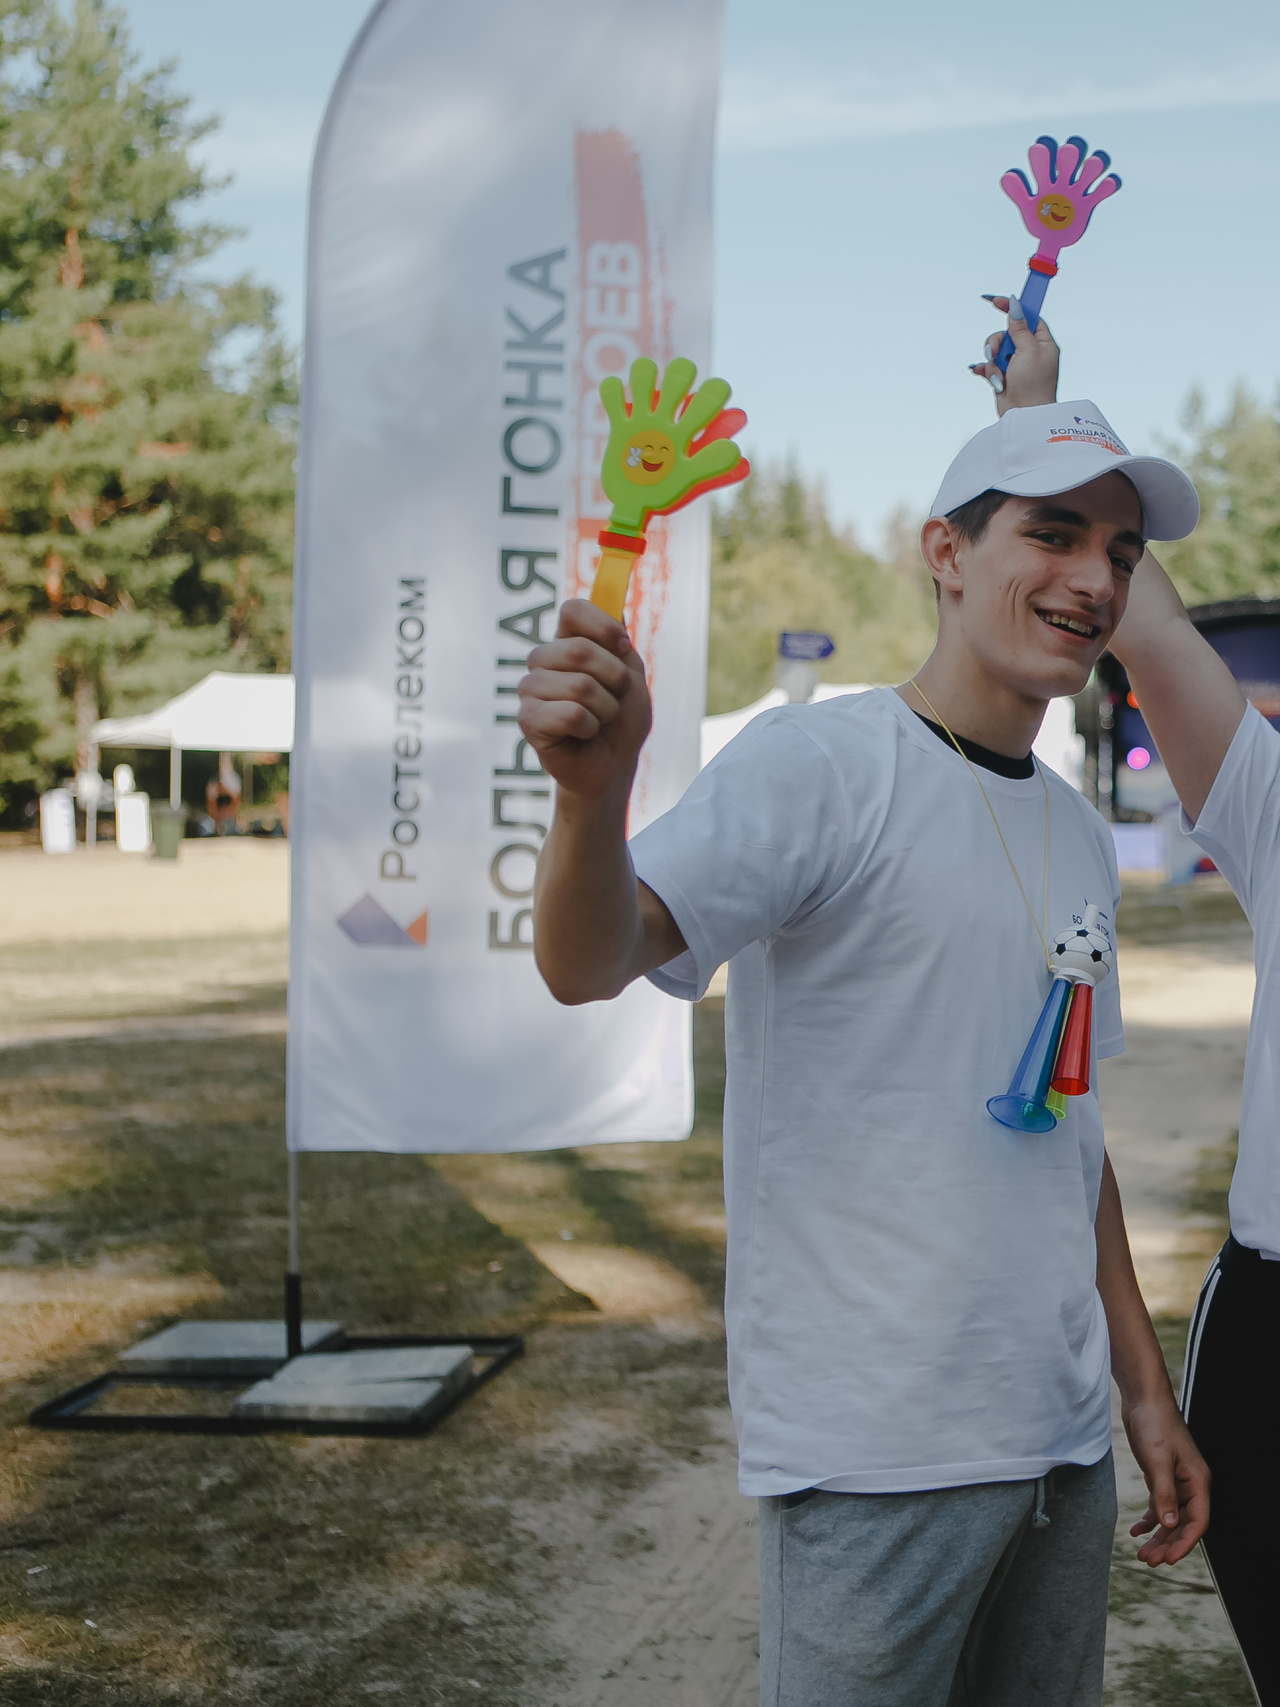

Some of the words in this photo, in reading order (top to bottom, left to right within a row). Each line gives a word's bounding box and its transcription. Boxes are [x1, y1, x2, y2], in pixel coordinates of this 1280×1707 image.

[501, 245, 568, 517] ГОНКА
[1049, 428, 1108, 440] БОЛЬШАЯ
[379, 576, 427, 883] Ростелеком
